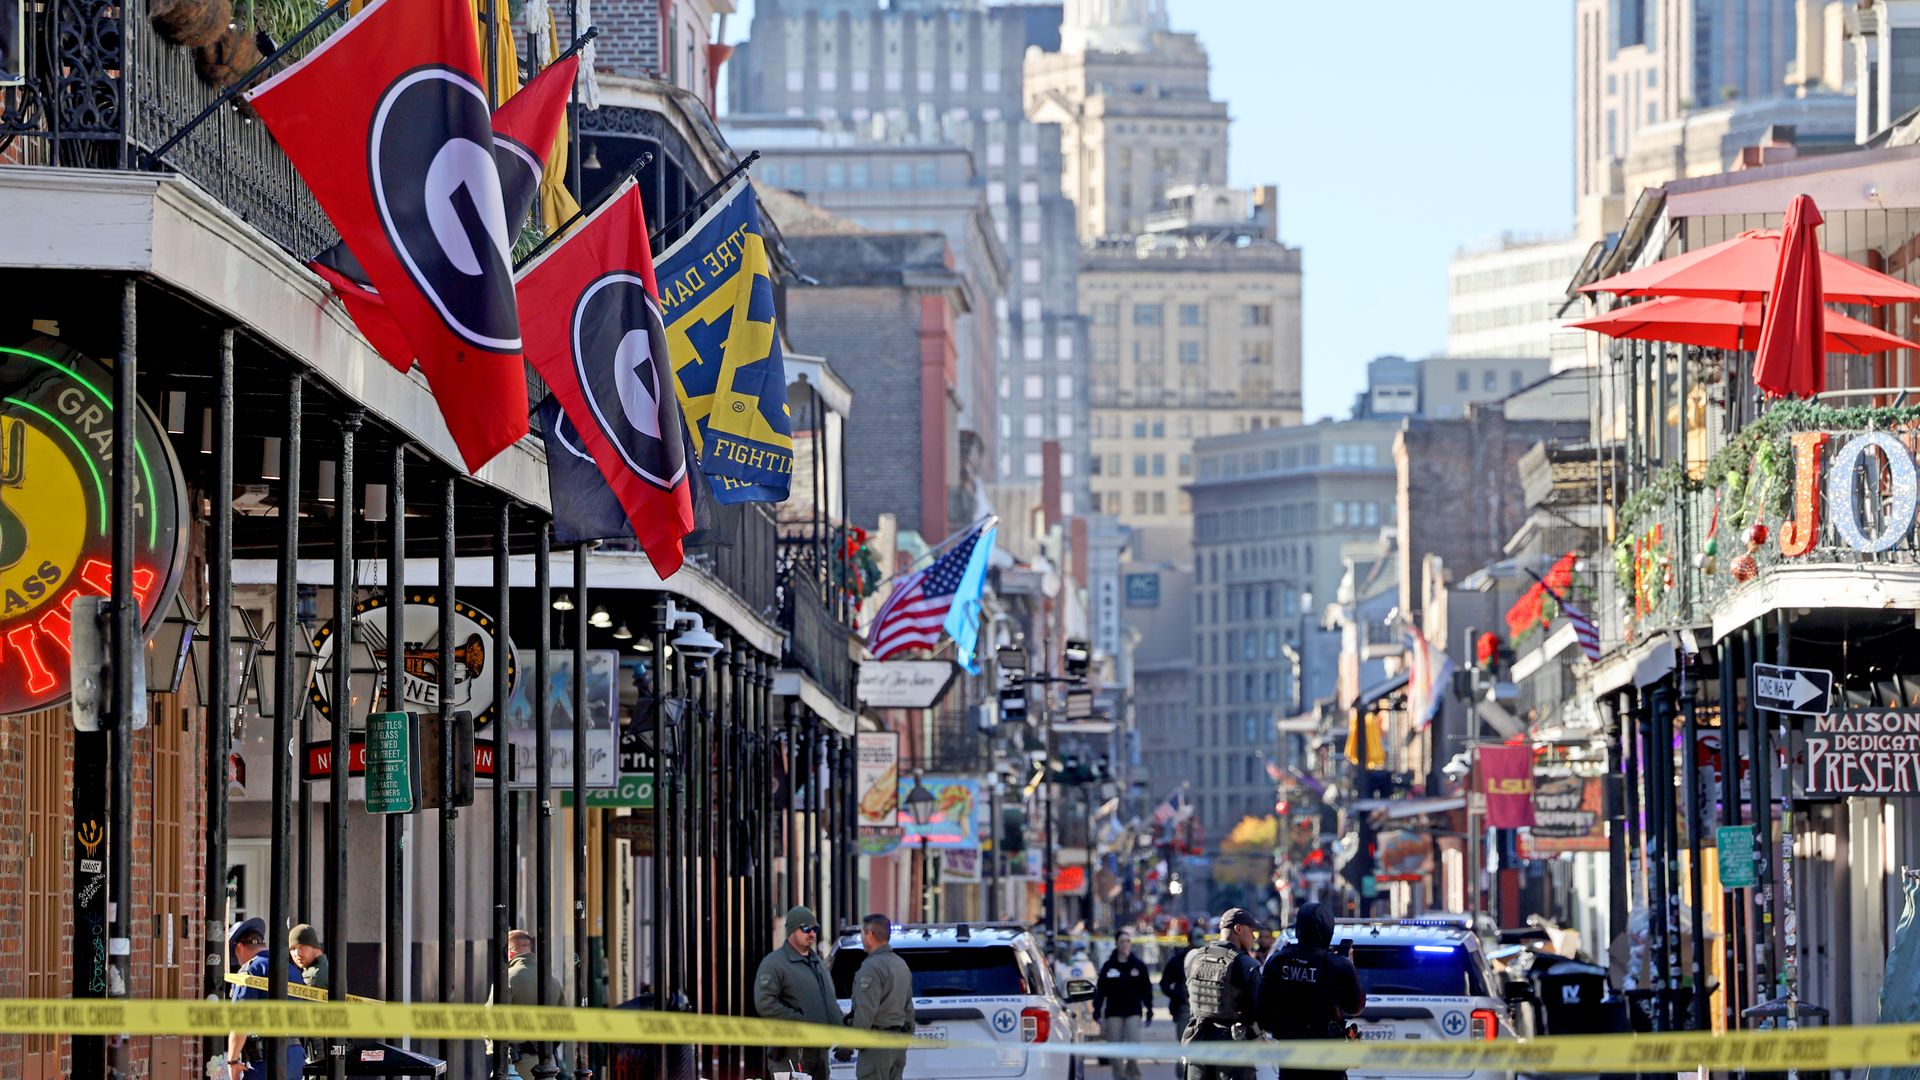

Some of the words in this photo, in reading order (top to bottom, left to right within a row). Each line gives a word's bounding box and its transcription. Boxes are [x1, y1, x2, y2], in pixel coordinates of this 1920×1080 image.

[1759, 677, 1773, 695] ONE
[1774, 680, 1793, 698] WAY
[1834, 734, 1920, 751] DEDICAT
[1488, 778, 1532, 795] LSU
